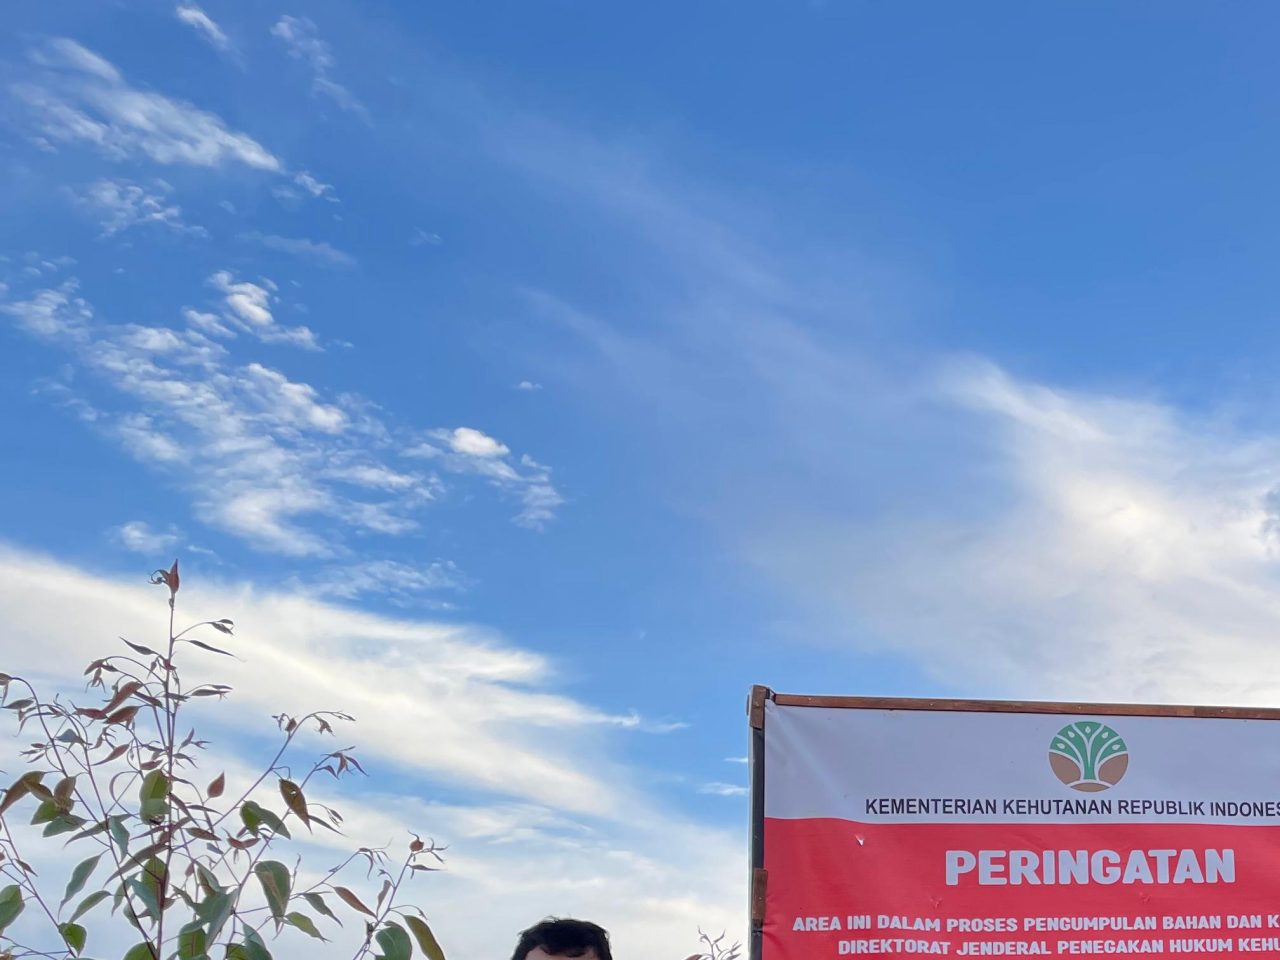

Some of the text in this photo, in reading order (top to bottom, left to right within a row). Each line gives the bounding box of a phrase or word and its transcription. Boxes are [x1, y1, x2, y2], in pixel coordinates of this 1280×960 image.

[865, 798, 997, 814] KEMENTERIAN
[1003, 799, 1112, 814] KEHUTANAN
[1117, 799, 1206, 815] REPUBLIK
[945, 848, 1236, 885] PERINGATAN
[792, 916, 842, 931] AREA
[847, 914, 872, 929] INI
[877, 914, 941, 931] DALAM
[946, 917, 1018, 932] PROSES
[1023, 916, 1157, 931] PENGUMPULAN
[1162, 915, 1222, 929] BAHAN
[1226, 914, 1262, 928] DAN
[838, 938, 952, 954] DIREKTORAT
[956, 940, 1052, 955] JENDERAL
[1057, 939, 1164, 954] PENEGAKAN
[1169, 938, 1233, 952] HUKUM
